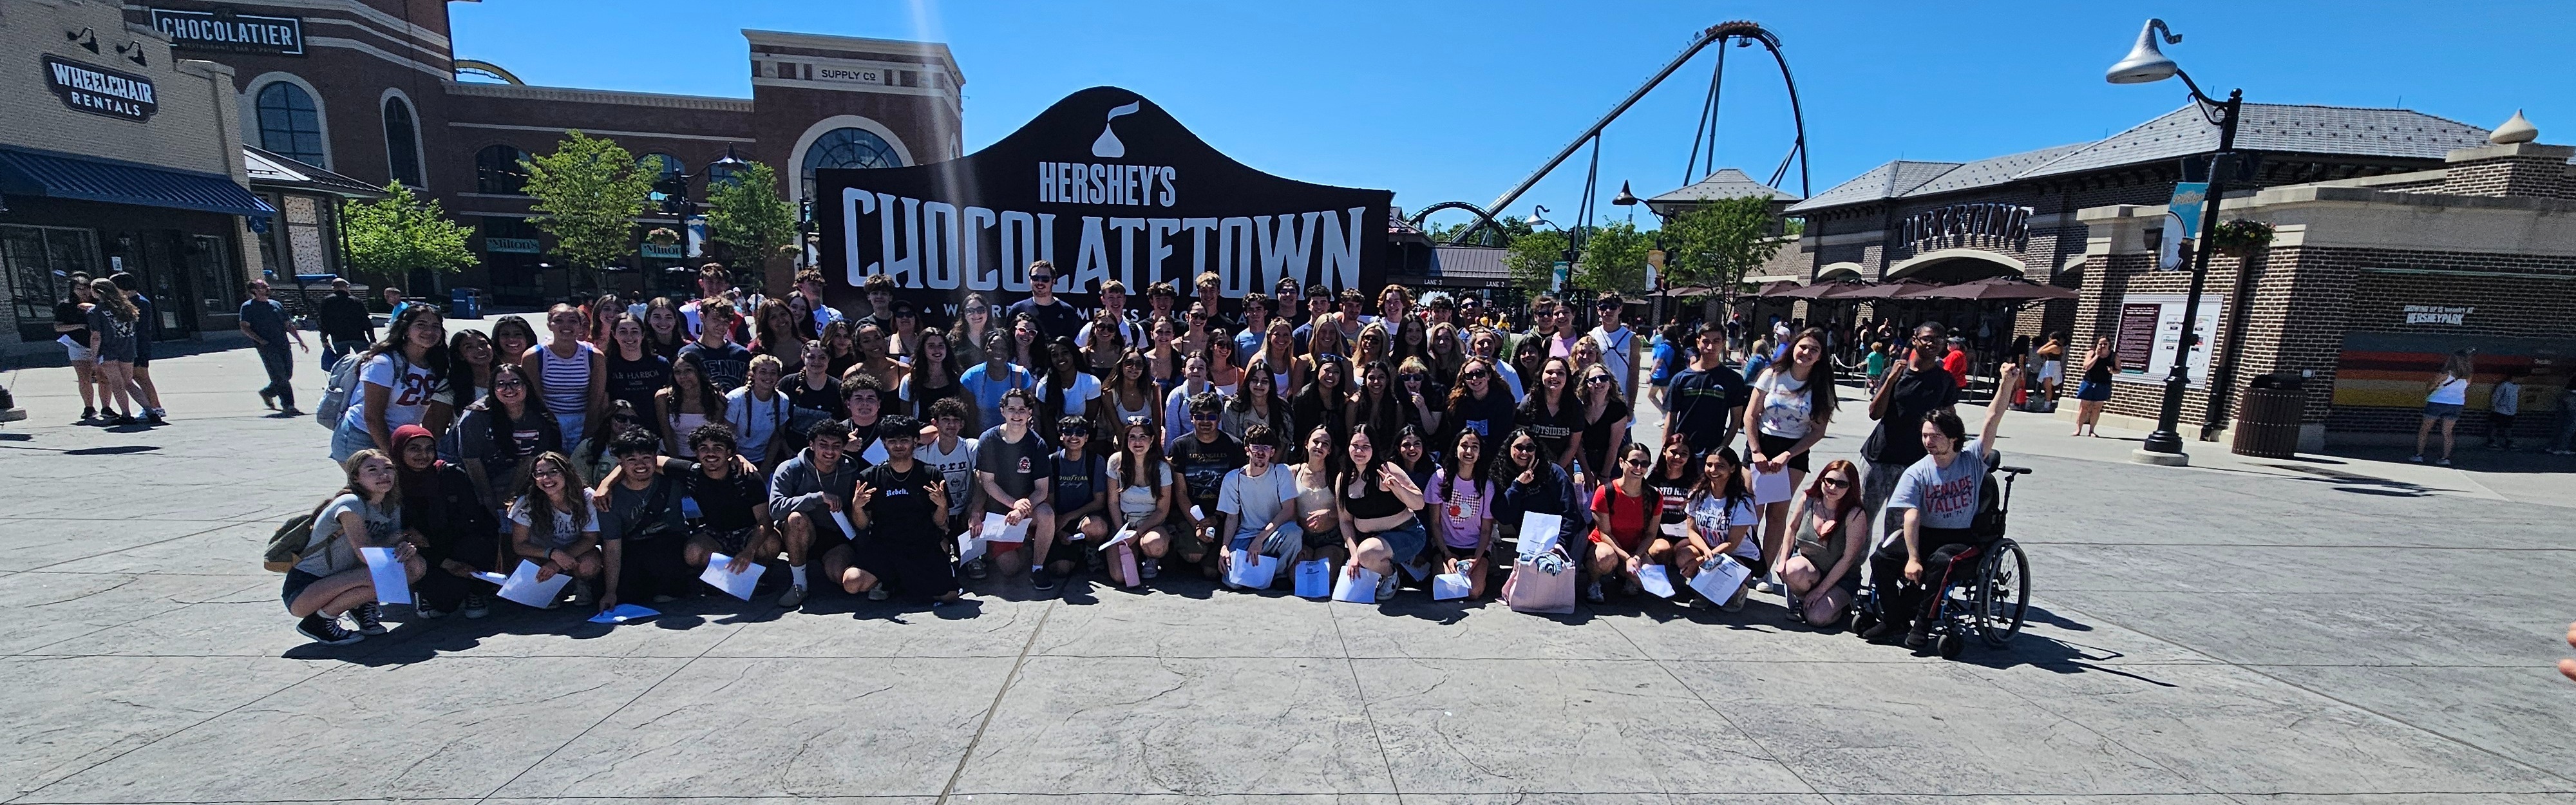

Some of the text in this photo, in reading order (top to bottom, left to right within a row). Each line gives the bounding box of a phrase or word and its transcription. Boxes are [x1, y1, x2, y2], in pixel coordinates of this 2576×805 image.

[162, 17, 292, 46] CHOCOLATIER
[50, 62, 154, 104] WHEELCHAIR
[821, 70, 860, 79] SUPPLY
[71, 91, 141, 117] RENTALS
[1039, 162, 1175, 207] HERSHEY'S
[1899, 203, 2034, 248] TICKETING
[489, 238, 538, 249] Milton's
[842, 187, 1366, 301] CHOCOLATETOWN
[2407, 312, 2465, 325] HERSHEYPARK
[703, 359, 746, 382] ENN
[1532, 424, 1569, 436] OUTSIDERS
[1925, 475, 1973, 499] LENAPE
[1925, 491, 1973, 513] VALLEY
[1696, 513, 1731, 531] OGETHER
